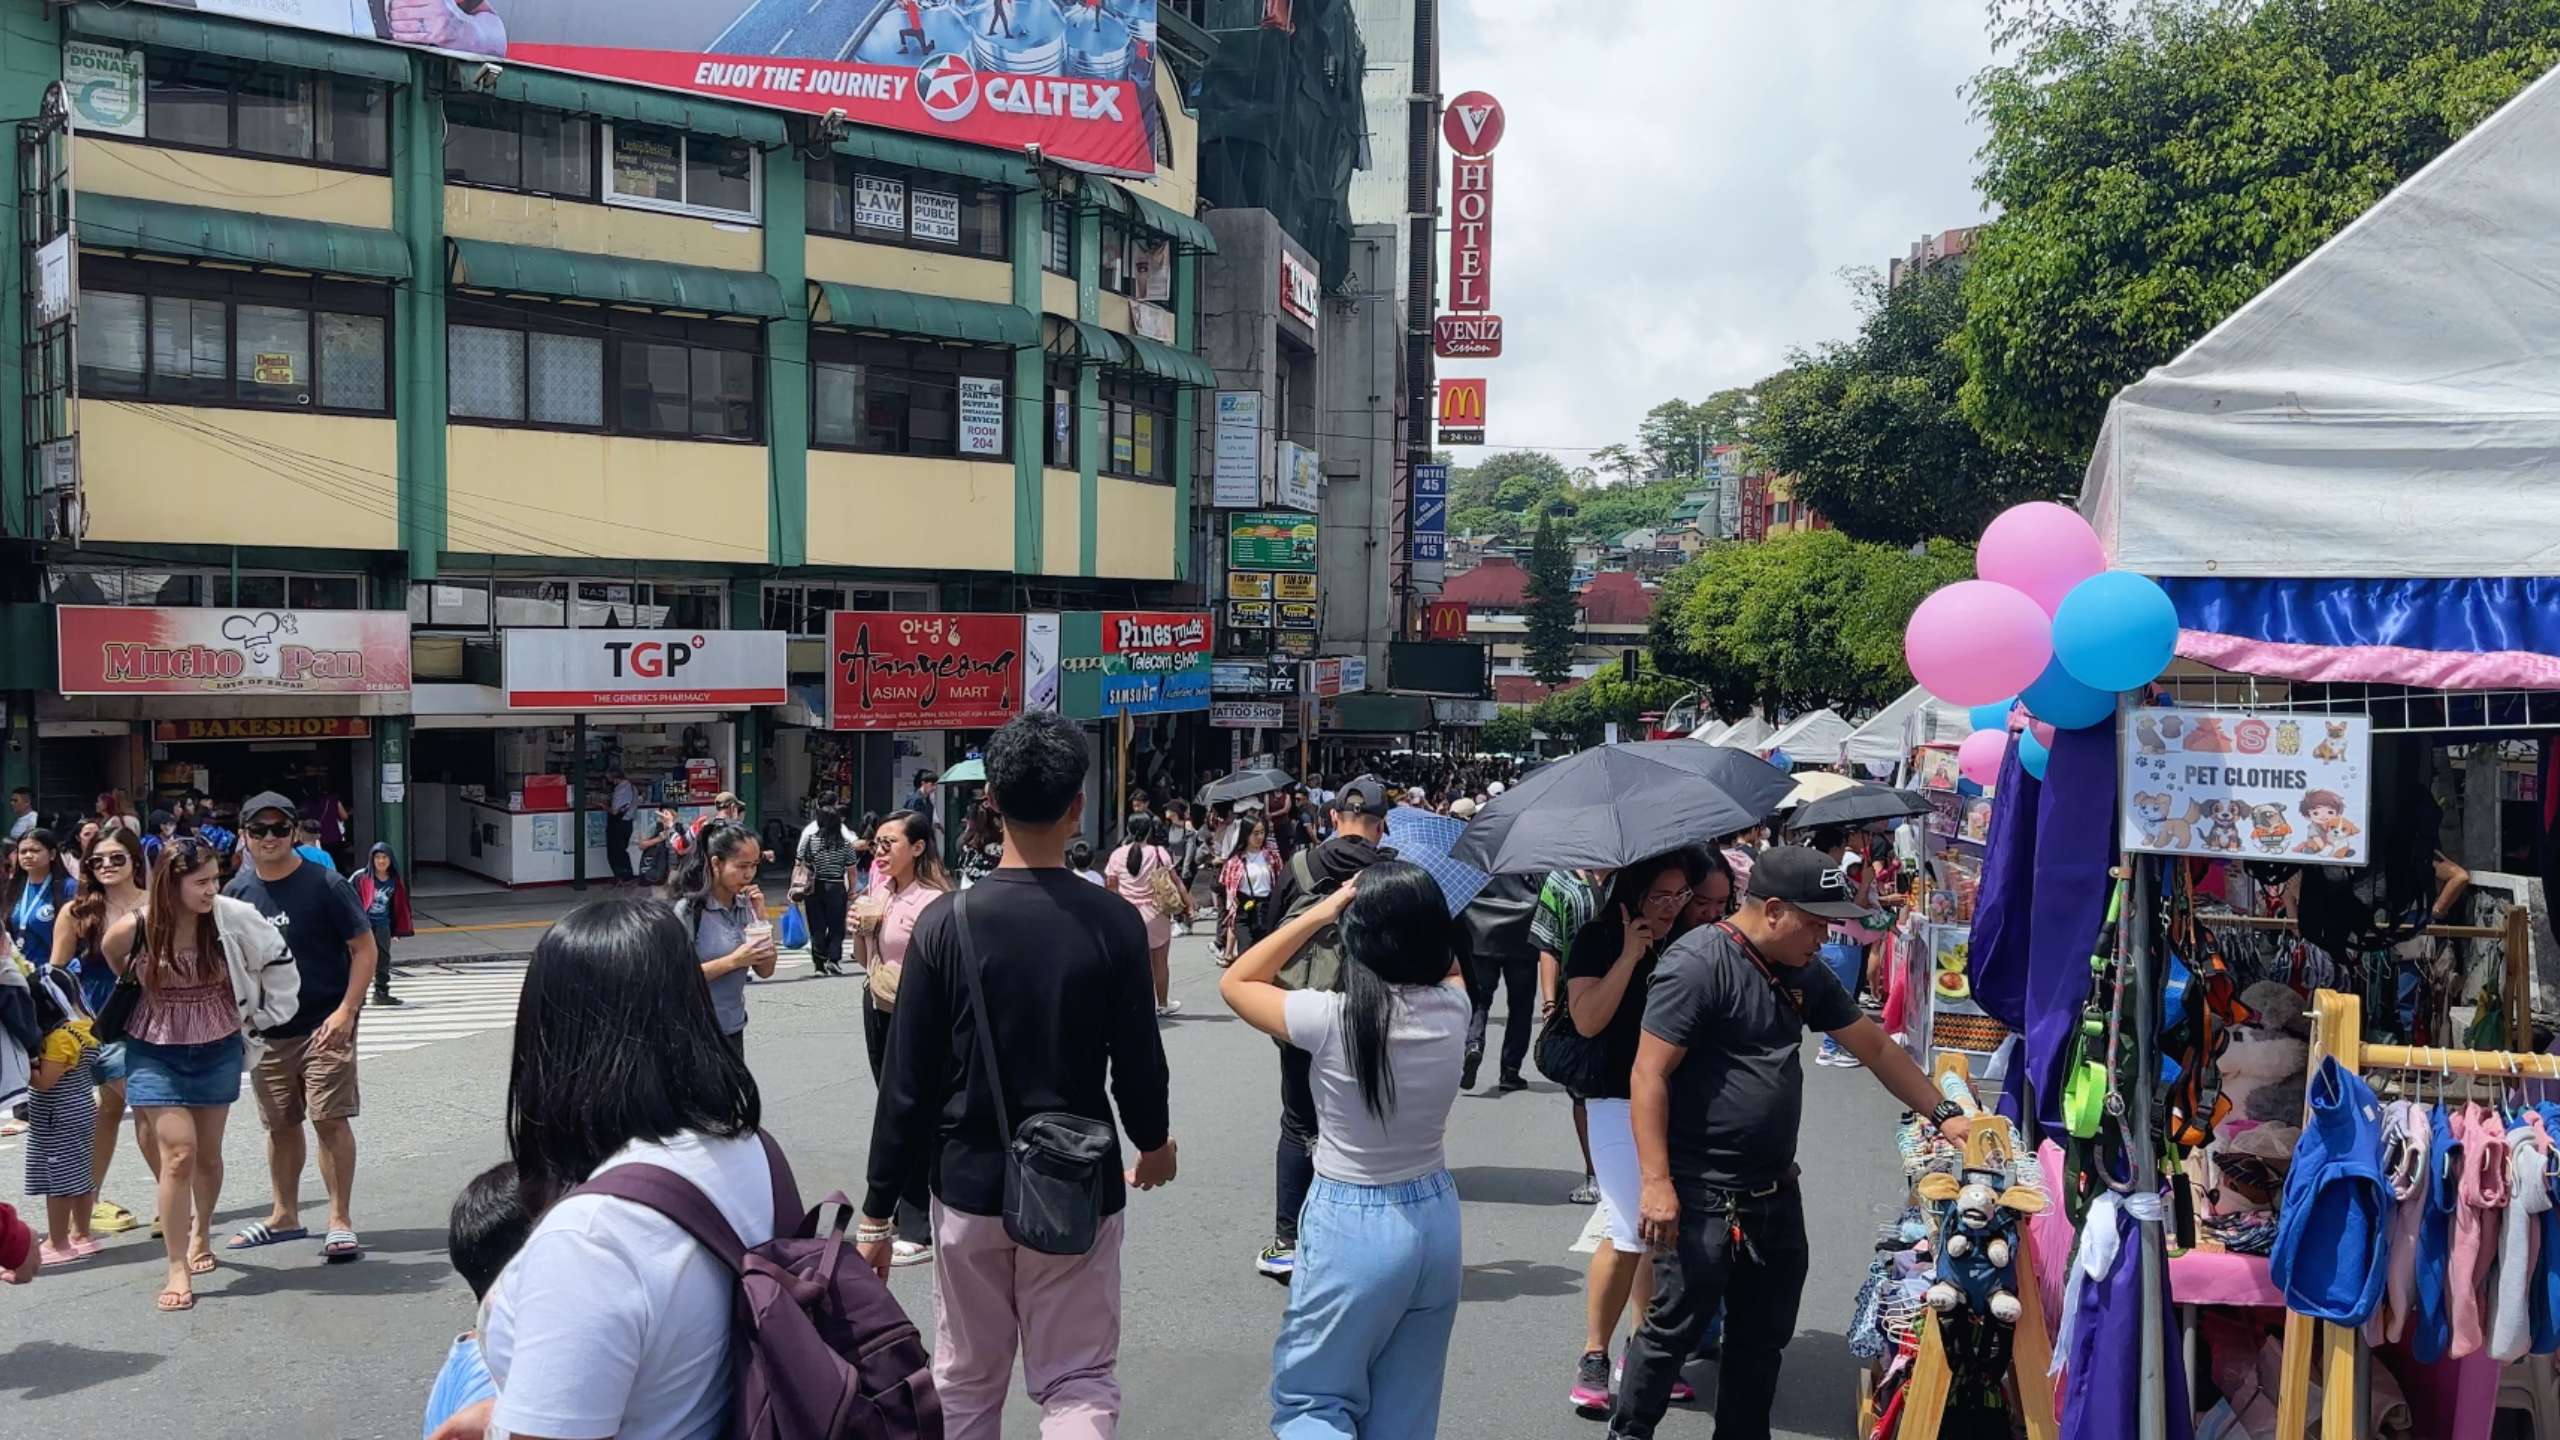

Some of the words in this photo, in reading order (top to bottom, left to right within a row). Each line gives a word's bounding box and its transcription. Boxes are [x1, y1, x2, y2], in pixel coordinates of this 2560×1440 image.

[694, 62, 763, 87] ENJOY
[762, 67, 803, 92] THE
[804, 70, 908, 101] JOURNEY
[984, 78, 1123, 122] CALTEX
[1455, 105, 1496, 146] V
[856, 179, 901, 195] BEJAR
[856, 190, 902, 212] LAW
[914, 194, 956, 210] NOTARY
[856, 211, 902, 227] OFFICE
[914, 205, 956, 221] PUBLIC
[935, 224, 956, 238] 304
[1459, 164, 1488, 305] HOTEL
[1445, 340, 1491, 354] Session
[967, 425, 997, 436] ROOM
[972, 437, 994, 449] 204
[1416, 468, 1445, 479] HOTEL
[1422, 479, 1440, 491] 45
[1415, 534, 1443, 544] HOTEL
[1420, 544, 1437, 557] 45
[899, 618, 943, 645] 안녕
[1117, 616, 1172, 649] Pines
[104, 643, 244, 681] Mucho
[280, 645, 364, 681] Pan
[603, 641, 692, 678] TGP
[839, 622, 1017, 710] Annyeong
[1128, 650, 1173, 671] Telecom
[216, 680, 243, 689] LOTS
[267, 679, 304, 689] BREAD
[365, 683, 405, 691] SESSION
[1270, 677, 1295, 689] TFC
[593, 693, 610, 703] THE
[612, 693, 658, 703] GENERICS
[659, 692, 710, 703] PHARMACY
[872, 686, 918, 700] ASIAN
[950, 685, 991, 698] MART
[1211, 707, 1251, 718] TATTOO
[1252, 707, 1282, 718] SHOP
[188, 717, 340, 738] BAKESHOP
[2184, 764, 2219, 786] PET
[2224, 766, 2308, 790] CLOTHES
